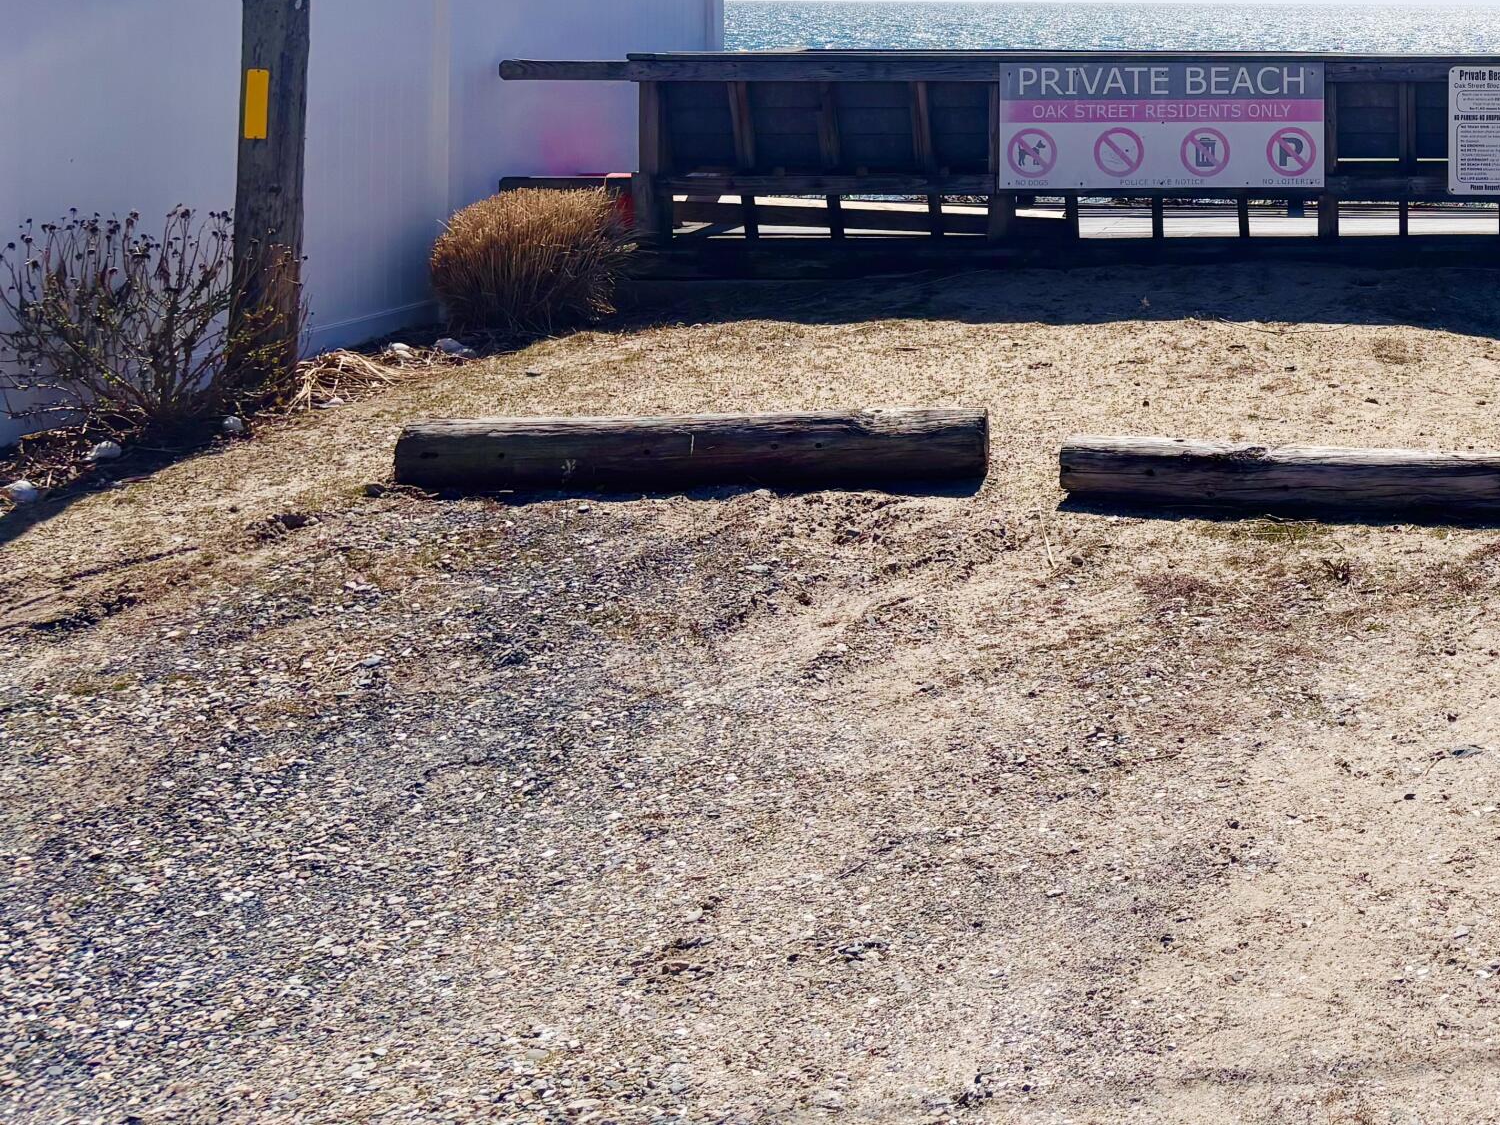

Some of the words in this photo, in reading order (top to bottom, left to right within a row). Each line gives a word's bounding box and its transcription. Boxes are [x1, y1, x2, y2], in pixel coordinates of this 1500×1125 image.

[1019, 67, 1169, 95] PRIVATE
[1185, 67, 1305, 95] BEACH
[1459, 69, 1486, 81] Private
[1032, 104, 1069, 118] OAK
[1074, 104, 1139, 118] STREET
[1145, 104, 1242, 118] RESIDENTS
[1248, 104, 1292, 118] ONLY
[1015, 178, 1026, 186] NO
[1028, 178, 1049, 186] DOGS
[1262, 178, 1274, 186] NO
[1276, 178, 1321, 186] LOITERING
